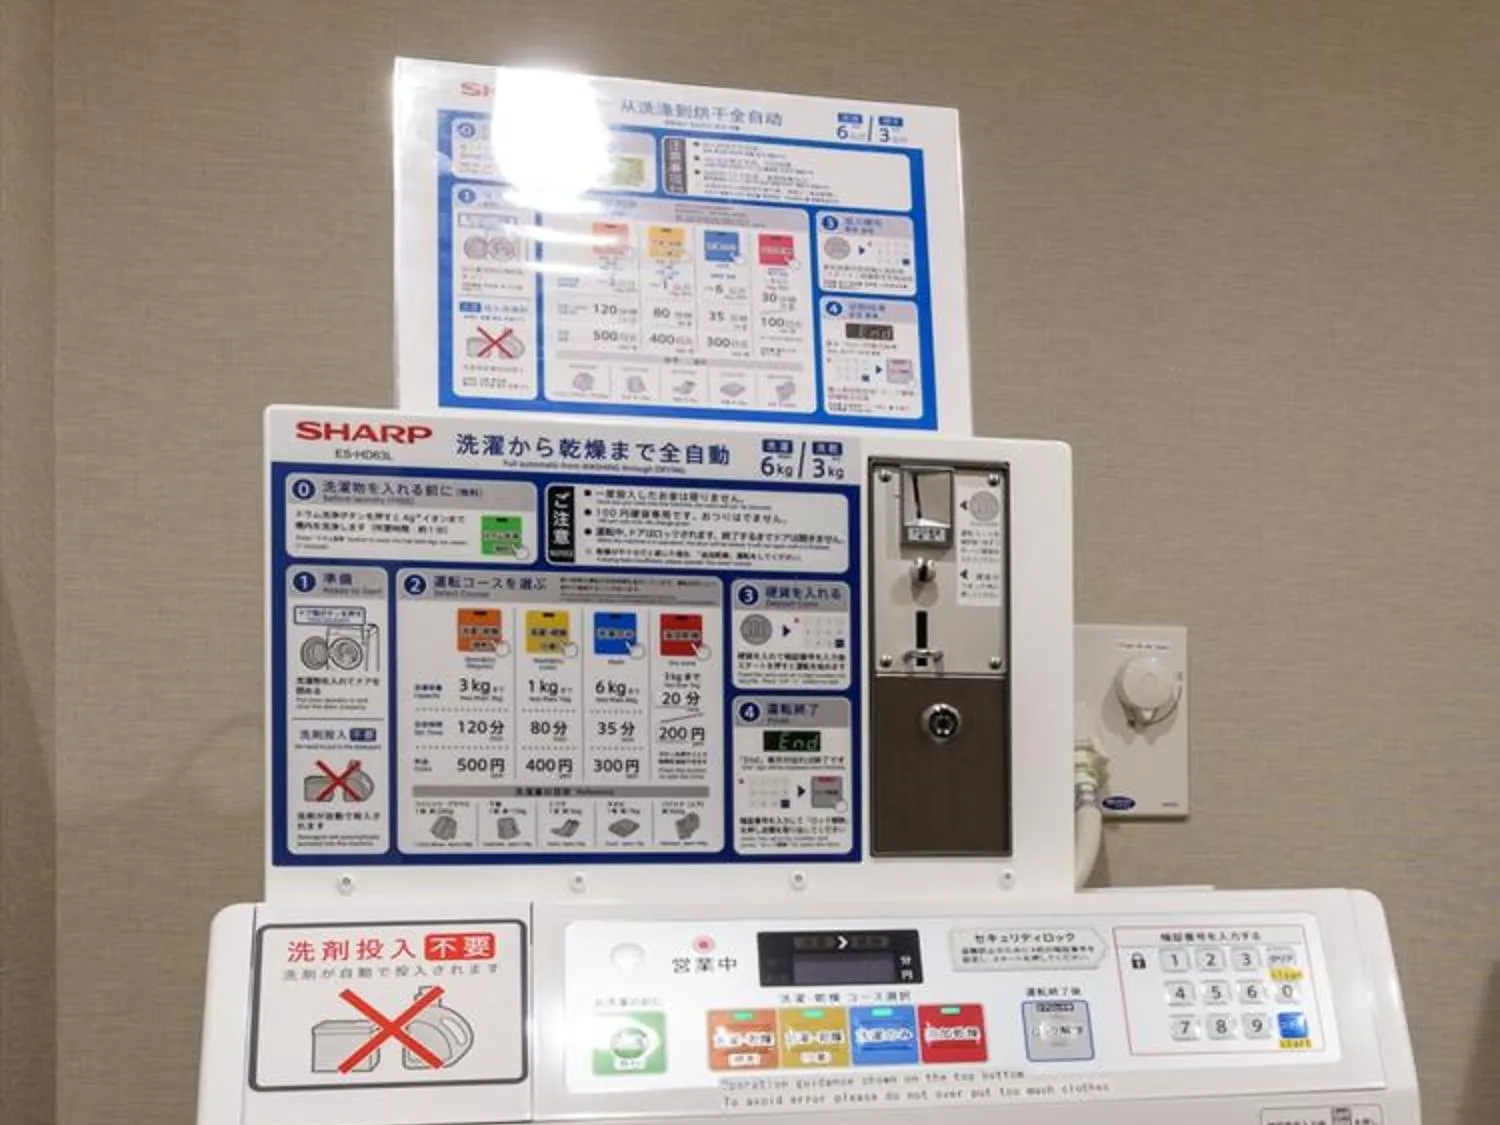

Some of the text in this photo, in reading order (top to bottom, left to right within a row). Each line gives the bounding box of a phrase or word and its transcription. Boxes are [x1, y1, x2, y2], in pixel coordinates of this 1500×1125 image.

[836, 124, 890, 143] 6 3
[593, 304, 617, 315] 120
[593, 331, 618, 342] 500
[649, 333, 675, 345] 400
[295, 421, 433, 445] SHARP
[455, 432, 731, 466] 洗濯から乾燥まで全自動
[459, 678, 491, 696] 3 kg
[539, 680, 559, 696] kg
[595, 681, 627, 698] 6 kg
[778, 732, 819, 750] End
[457, 759, 640, 775] 500円 400円 300円
[974, 931, 1076, 945] セキュリティロック
[287, 934, 493, 963] 洗剤投入 不要
[671, 957, 738, 974] 営業中
[1206, 953, 1217, 967] 2
[1242, 953, 1252, 967] 3
[282, 963, 500, 983] 洗剤が自動で投入されます
[1175, 985, 1293, 1000] 4 5 6 0
[1180, 1019, 1263, 1034] 7 8 9
[926, 1072, 947, 1082] the
[834, 1092, 878, 1103] please
[907, 1091, 928, 1100] not
[970, 1088, 991, 1099] put
[1026, 1085, 1054, 1096] much
